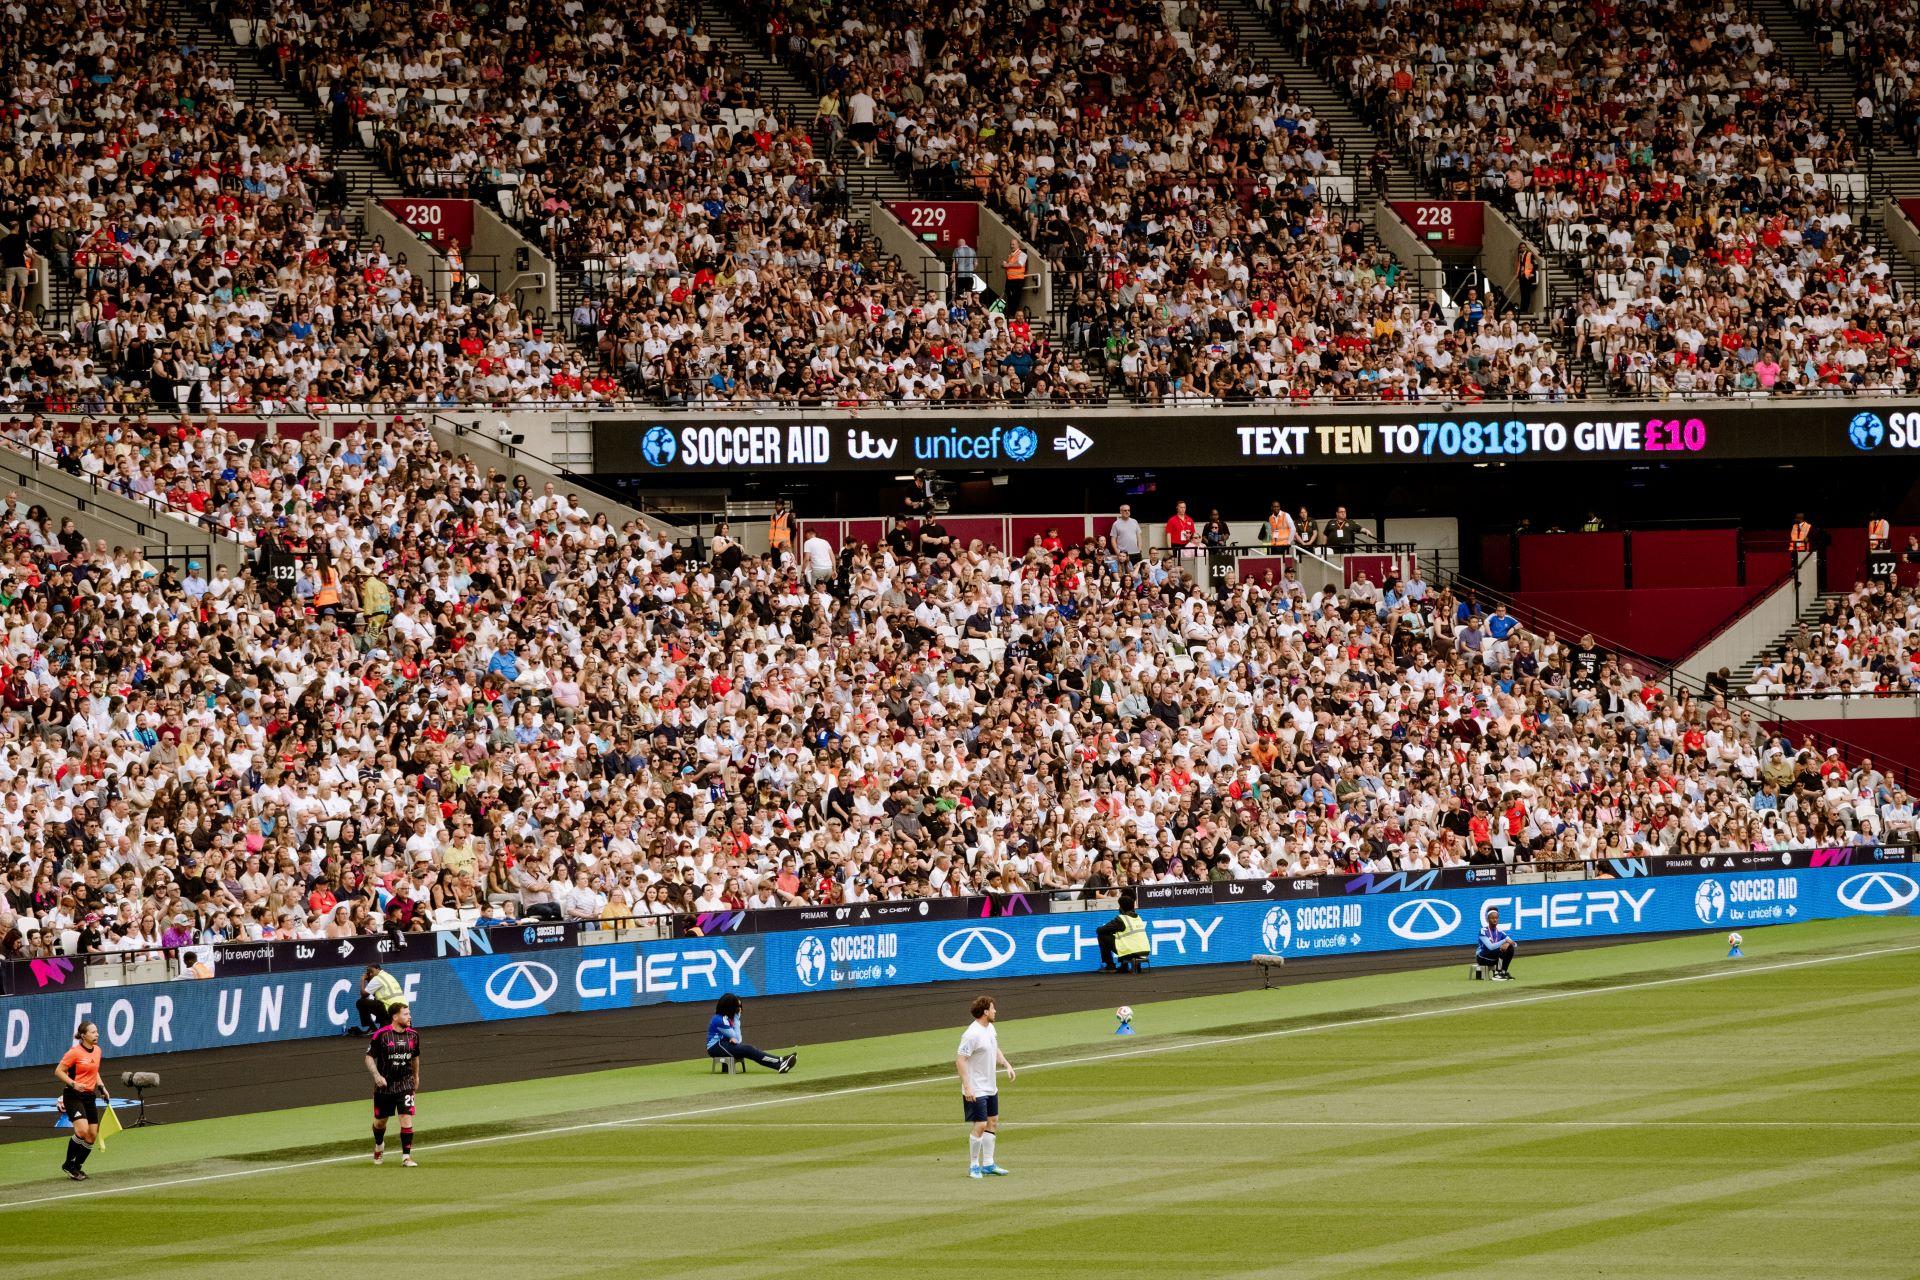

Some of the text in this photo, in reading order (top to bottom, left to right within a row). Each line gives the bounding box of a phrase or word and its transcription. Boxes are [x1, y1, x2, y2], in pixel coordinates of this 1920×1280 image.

[405, 205, 442, 225] 230
[911, 208, 946, 227] 229
[1416, 207, 1452, 225] 228
[848, 429, 898, 459] itv
[914, 426, 1001, 459] unicef
[1053, 427, 1092, 456] stv
[1237, 419, 1706, 455] TEXT TEN TO 70818 TO GIVE £10
[681, 426, 830, 465] SOCCER AID
[272, 565, 296, 580] 132
[684, 560, 702, 572] 13
[1872, 562, 1896, 575] 127
[1147, 887, 1165, 898] unicef
[1174, 885, 1213, 897] for every child
[1229, 884, 1244, 895] itv
[1730, 877, 1797, 902] SOCCER AID
[800, 911, 828, 919] PRIMARK
[1296, 904, 1361, 931] SOCCER AID
[1480, 888, 1656, 931] CHERY
[1730, 909, 1744, 920] itv
[1748, 906, 1772, 919] unicef
[1036, 916, 1224, 962] CHRY
[1296, 938, 1310, 949] itv
[1314, 934, 1337, 948] unicef
[225, 947, 274, 961] for every child
[296, 945, 315, 959] itv
[830, 933, 897, 962] SOCCER AID
[576, 946, 755, 998] CHERY
[831, 969, 844, 981] itv
[848, 966, 872, 980] unicef
[217, 972, 421, 1037] UNICF
